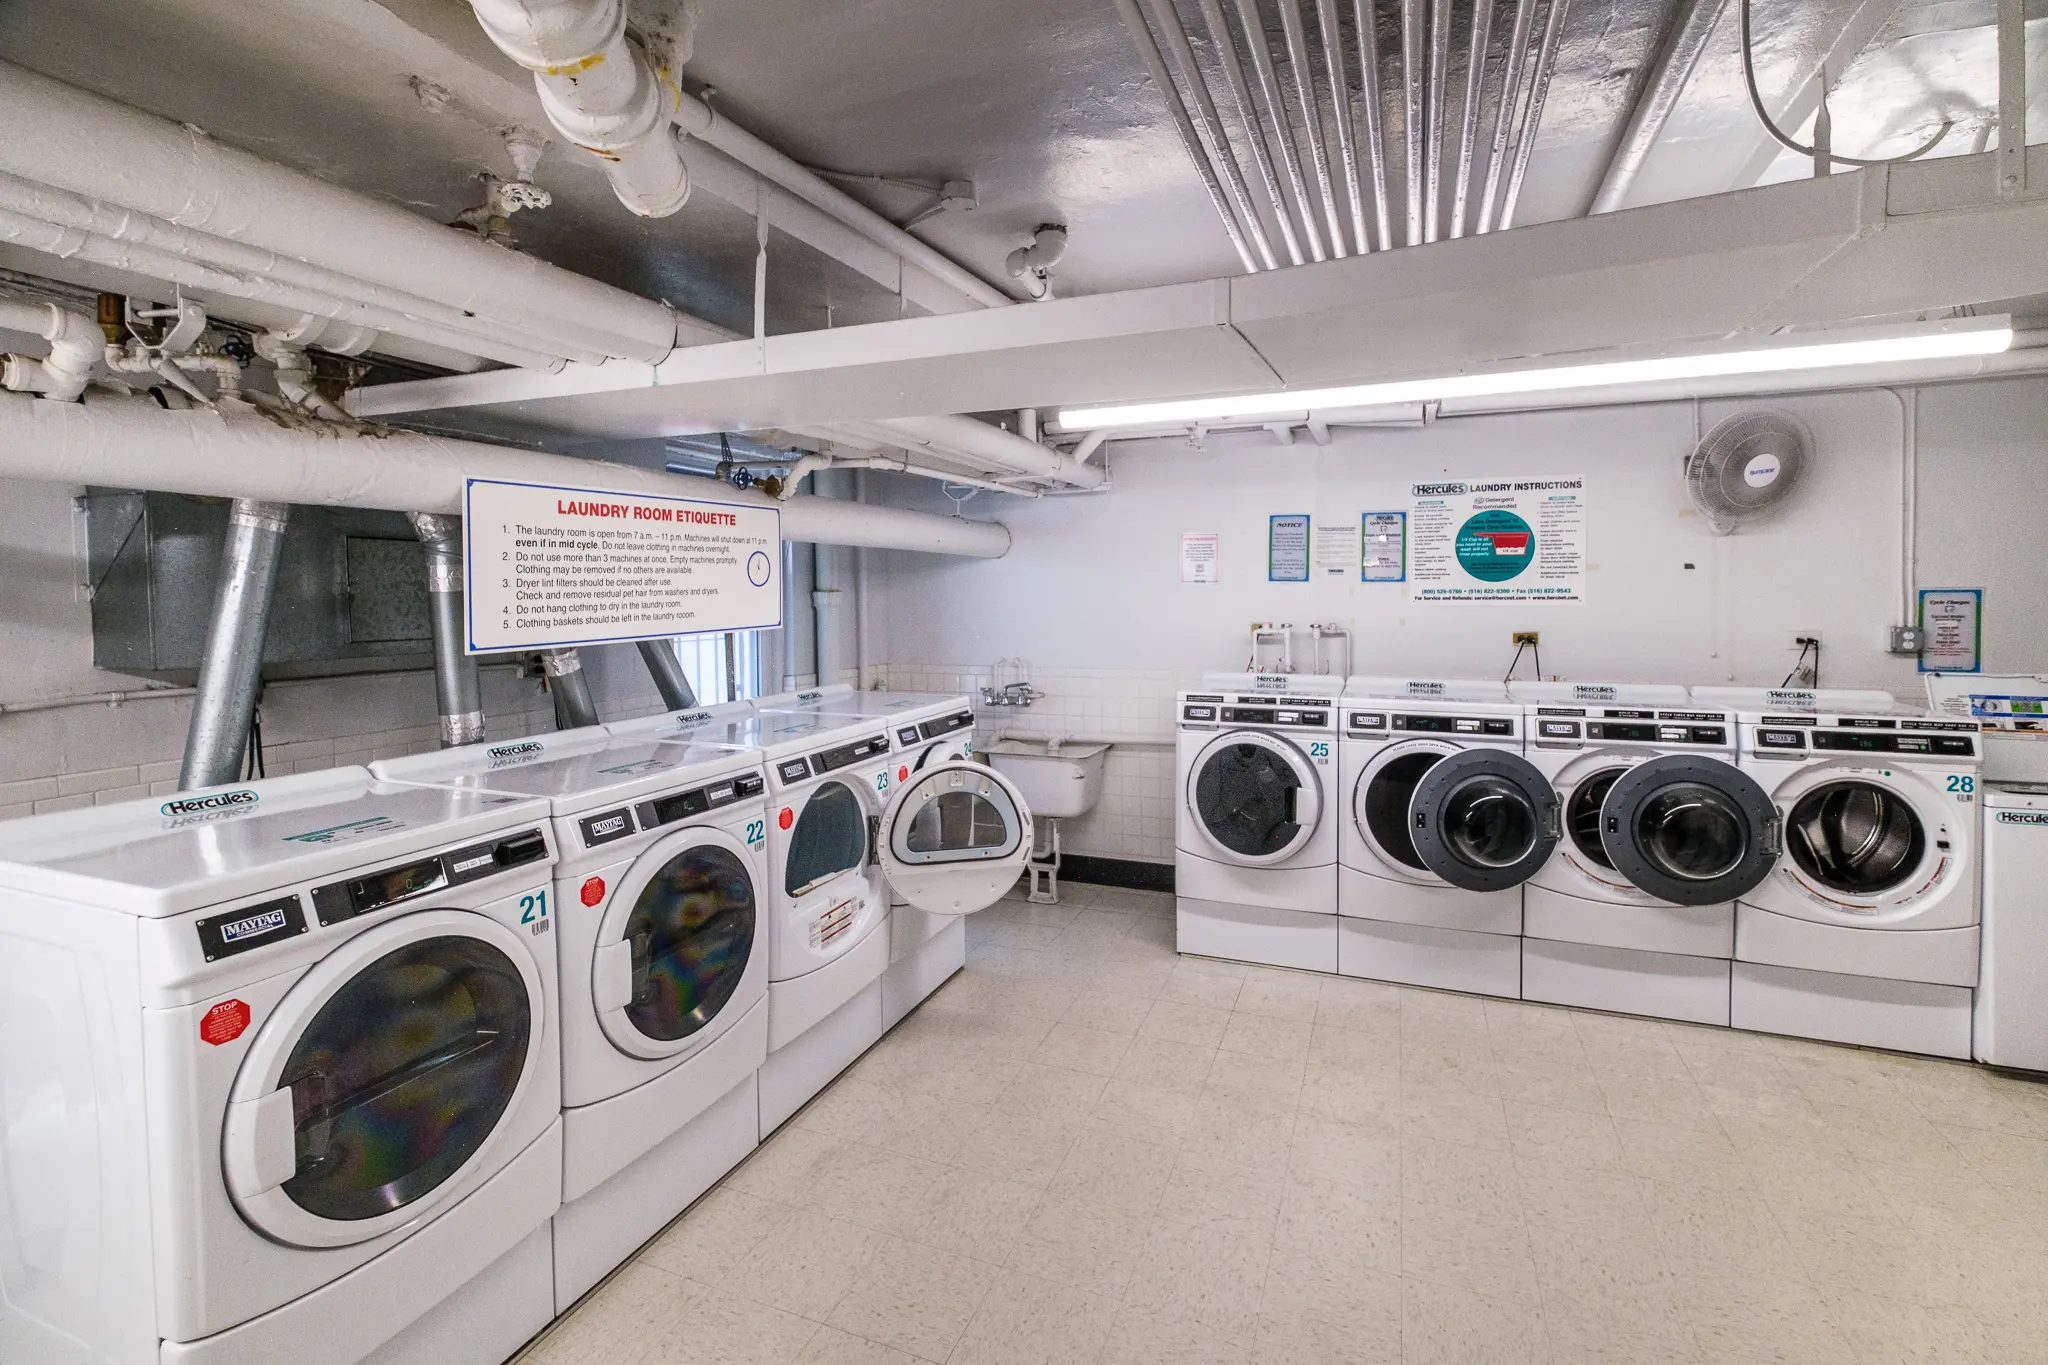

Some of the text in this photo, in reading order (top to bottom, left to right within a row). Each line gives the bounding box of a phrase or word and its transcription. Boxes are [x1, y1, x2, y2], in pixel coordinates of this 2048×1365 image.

[1416, 480, 1582, 494] Hercules LAUNDRY INSTRUCTIONS
[558, 500, 736, 526] LAUNDRY ROOM ETIQUETTE
[503, 525, 510, 534] 1.
[516, 524, 532, 535] The
[535, 526, 564, 538] laundry
[567, 529, 587, 537] room
[589, 529, 595, 537] is
[597, 531, 615, 539] open
[617, 530, 632, 539] from
[634, 531, 638, 539] 7
[684, 534, 710, 542] Machines
[711, 535, 719, 543] will
[515, 539, 537, 547] even
[540, 538, 546, 548] if
[548, 538, 556, 548] in
[559, 540, 574, 548] mid
[602, 541, 613, 549] Do
[615, 542, 625, 550] not
[646, 543, 670, 553] clothing
[678, 544, 704, 552] machines
[502, 552, 510, 561] 2.
[516, 552, 528, 561] Do
[531, 553, 544, 561] not
[564, 554, 583, 562] more
[585, 553, 601, 562] than
[603, 554, 608, 562] 3
[610, 554, 642, 562] machines
[670, 555, 688, 565] Empty
[516, 564, 550, 576] Clothing
[553, 567, 570, 576] may
[572, 565, 582, 574] be
[584, 566, 615, 574] removed
[633, 566, 653, 574] others
[503, 578, 511, 588] 3.
[516, 578, 539, 590] Dryer
[542, 578, 553, 587] lint
[556, 578, 577, 587] filters
[579, 578, 603, 587] should
[606, 578, 614, 586] be
[616, 578, 642, 586] cleaned
[644, 578, 658, 586] after
[516, 591, 543, 600] Check
[545, 591, 561, 599] and
[593, 589, 621, 598] residual
[623, 590, 633, 599] pet
[635, 589, 647, 597] hair
[649, 589, 663, 597] from
[503, 606, 511, 615] 4.
[516, 605, 528, 614] Do
[531, 605, 544, 614] not
[547, 604, 567, 615] hang
[569, 603, 598, 613] clothing
[609, 602, 619, 612] dry
[629, 602, 639, 610] the
[641, 601, 664, 610] laundry
[503, 619, 511, 629] 5.
[516, 618, 550, 629] Clothing
[553, 617, 583, 626] baskets
[586, 615, 609, 624] should
[611, 615, 619, 623] be
[622, 614, 631, 622] left
[634, 613, 639, 621] in
[641, 613, 651, 621] the
[653, 612, 675, 621] laundry
[797, 691, 823, 701] Hercules
[1770, 692, 1813, 700] Hercules
[678, 712, 711, 723] Hercules
[491, 744, 540, 758] Hercules
[964, 742, 972, 756] 24
[1311, 742, 1329, 757] 25
[877, 772, 888, 790] 23
[1947, 775, 1974, 793] 28
[169, 792, 254, 814] Hercules
[594, 818, 622, 831] MAYTAG
[746, 820, 764, 844] 22
[586, 878, 599, 886] STOP
[519, 890, 547, 925] 21
[225, 913, 281, 936] MAYTAG
[236, 924, 274, 937] COMMERCIAL
[212, 1001, 238, 1015] STOP
